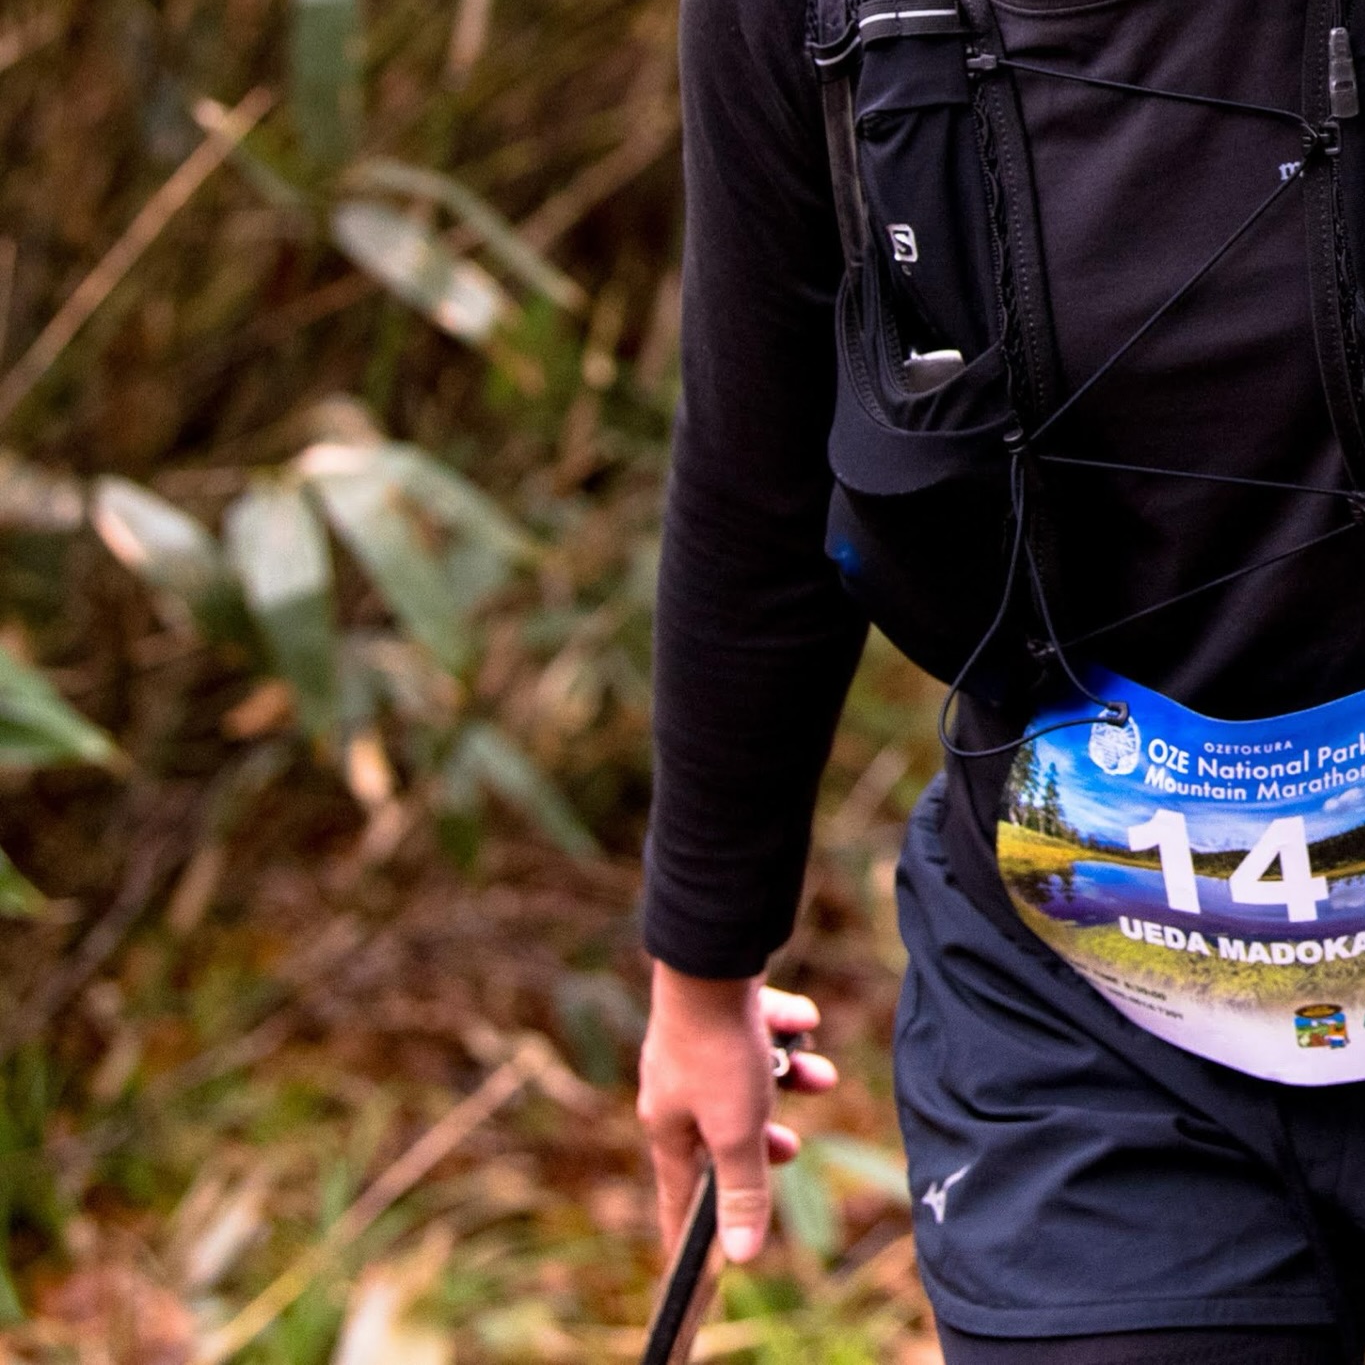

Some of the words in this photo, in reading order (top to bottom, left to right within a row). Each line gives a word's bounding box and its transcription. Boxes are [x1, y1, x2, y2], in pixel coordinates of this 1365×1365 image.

[1147, 738, 1191, 775] OZE
[1197, 749, 1310, 781] National
[1203, 740, 1294, 756] OZETOKURA
[1144, 764, 1248, 801] Mountain
[1127, 808, 1330, 923] 14
[1118, 915, 1212, 957] UEDA
